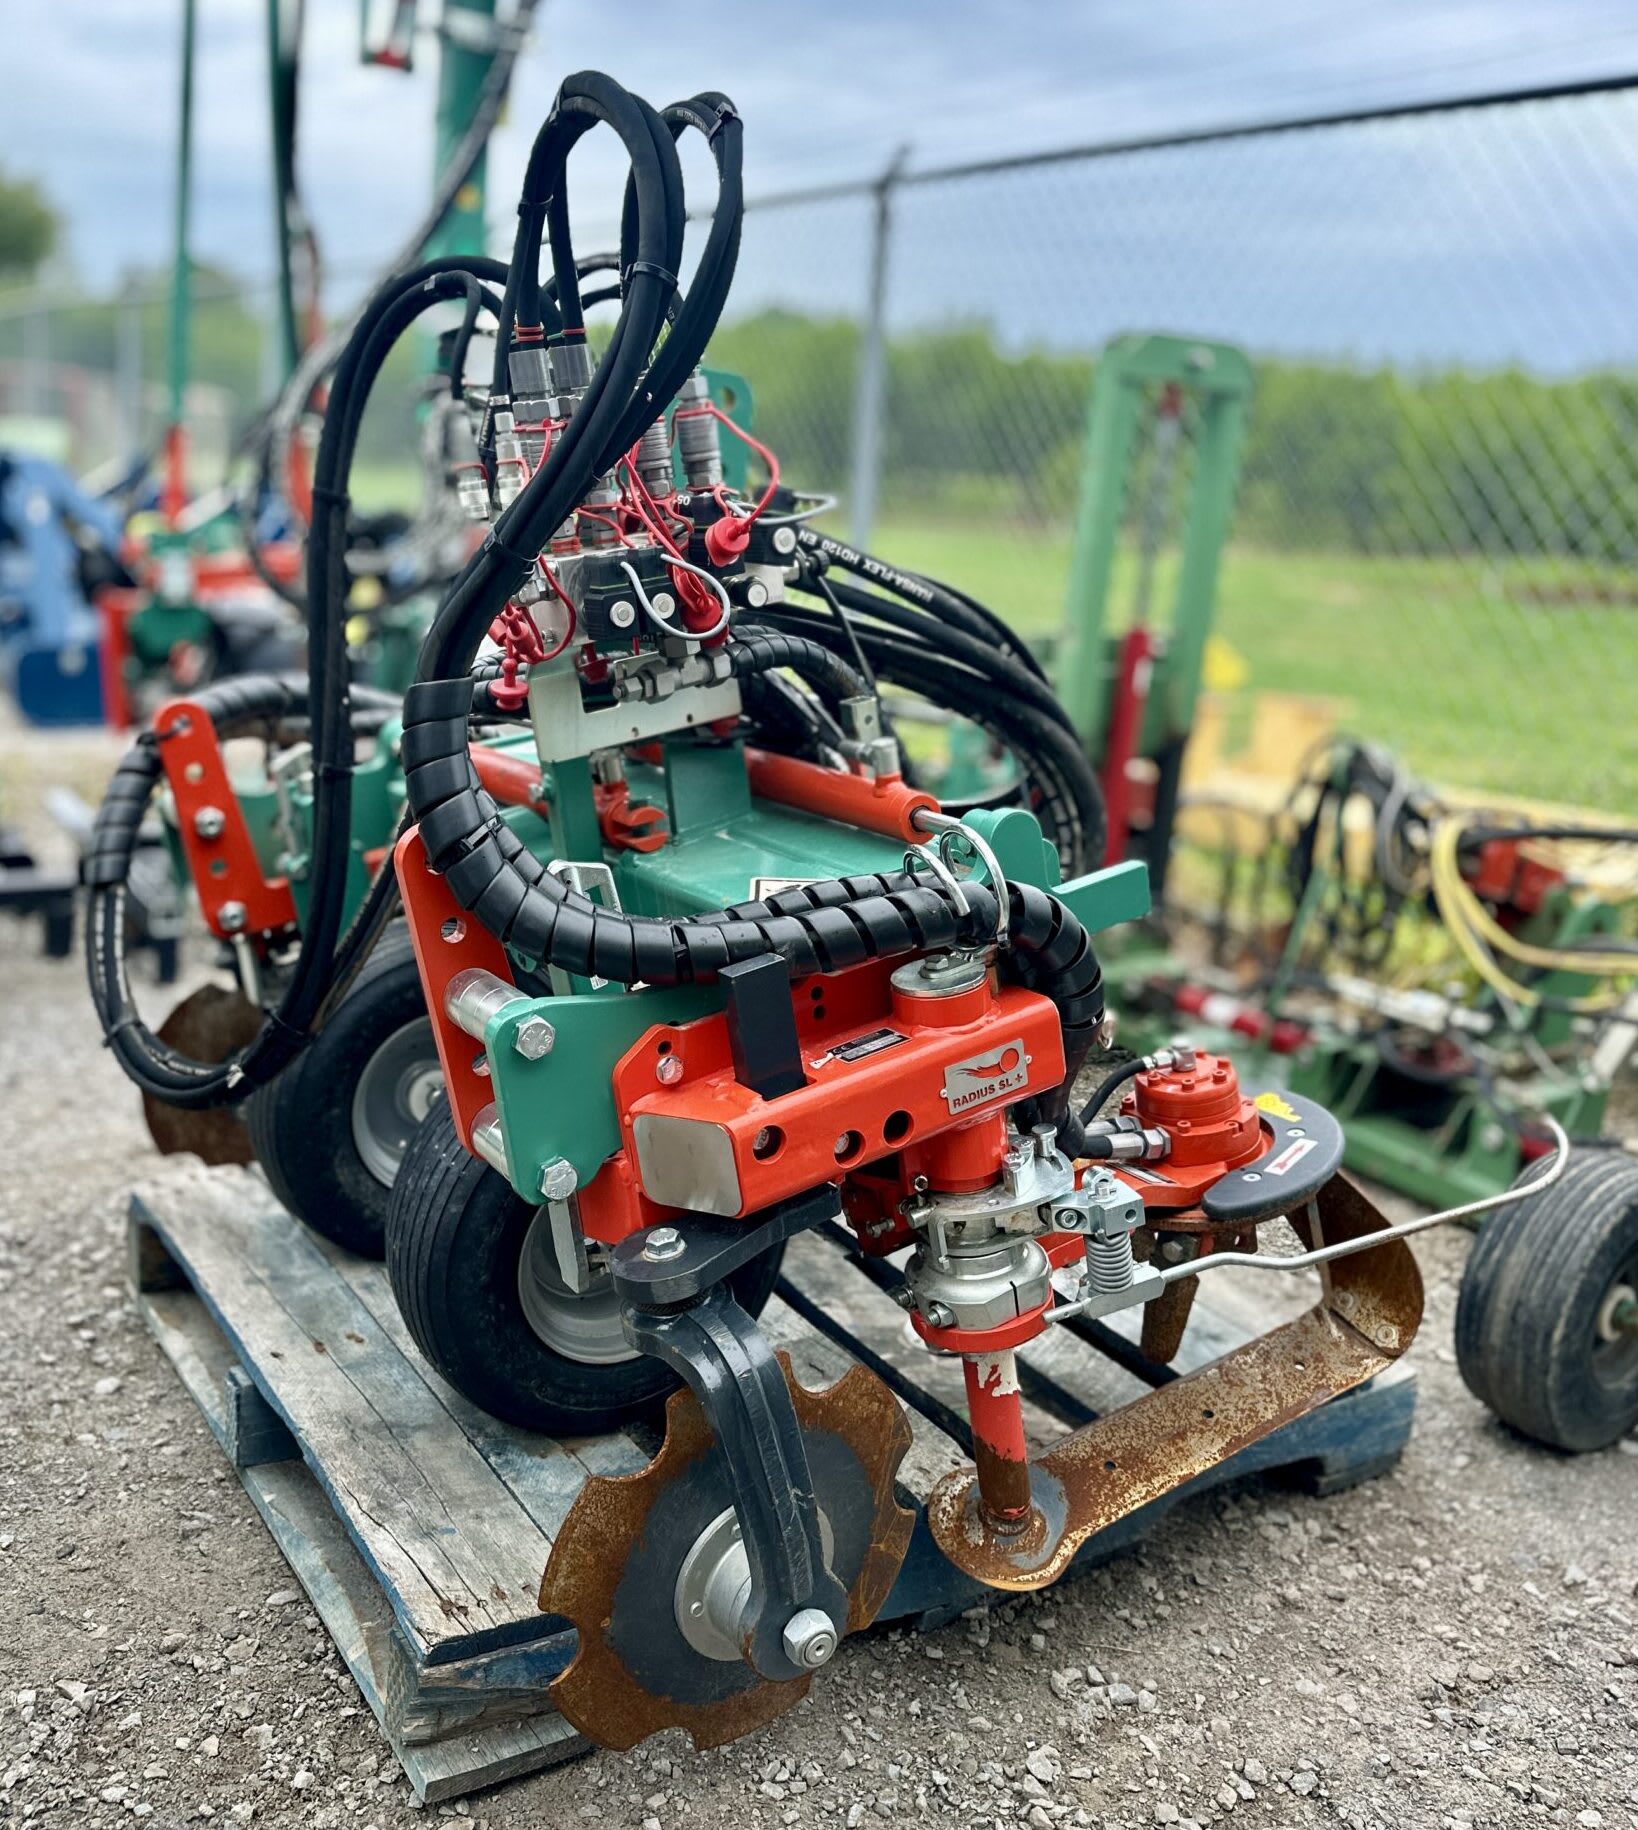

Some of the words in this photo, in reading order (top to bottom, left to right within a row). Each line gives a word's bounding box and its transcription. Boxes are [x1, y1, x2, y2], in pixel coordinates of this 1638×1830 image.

[798, 529, 818, 546] EN
[821, 538, 860, 564] HD120
[952, 1083, 996, 1108] RADIUS
[998, 1078, 1013, 1090] SL
[1015, 1072, 1023, 1083] +
